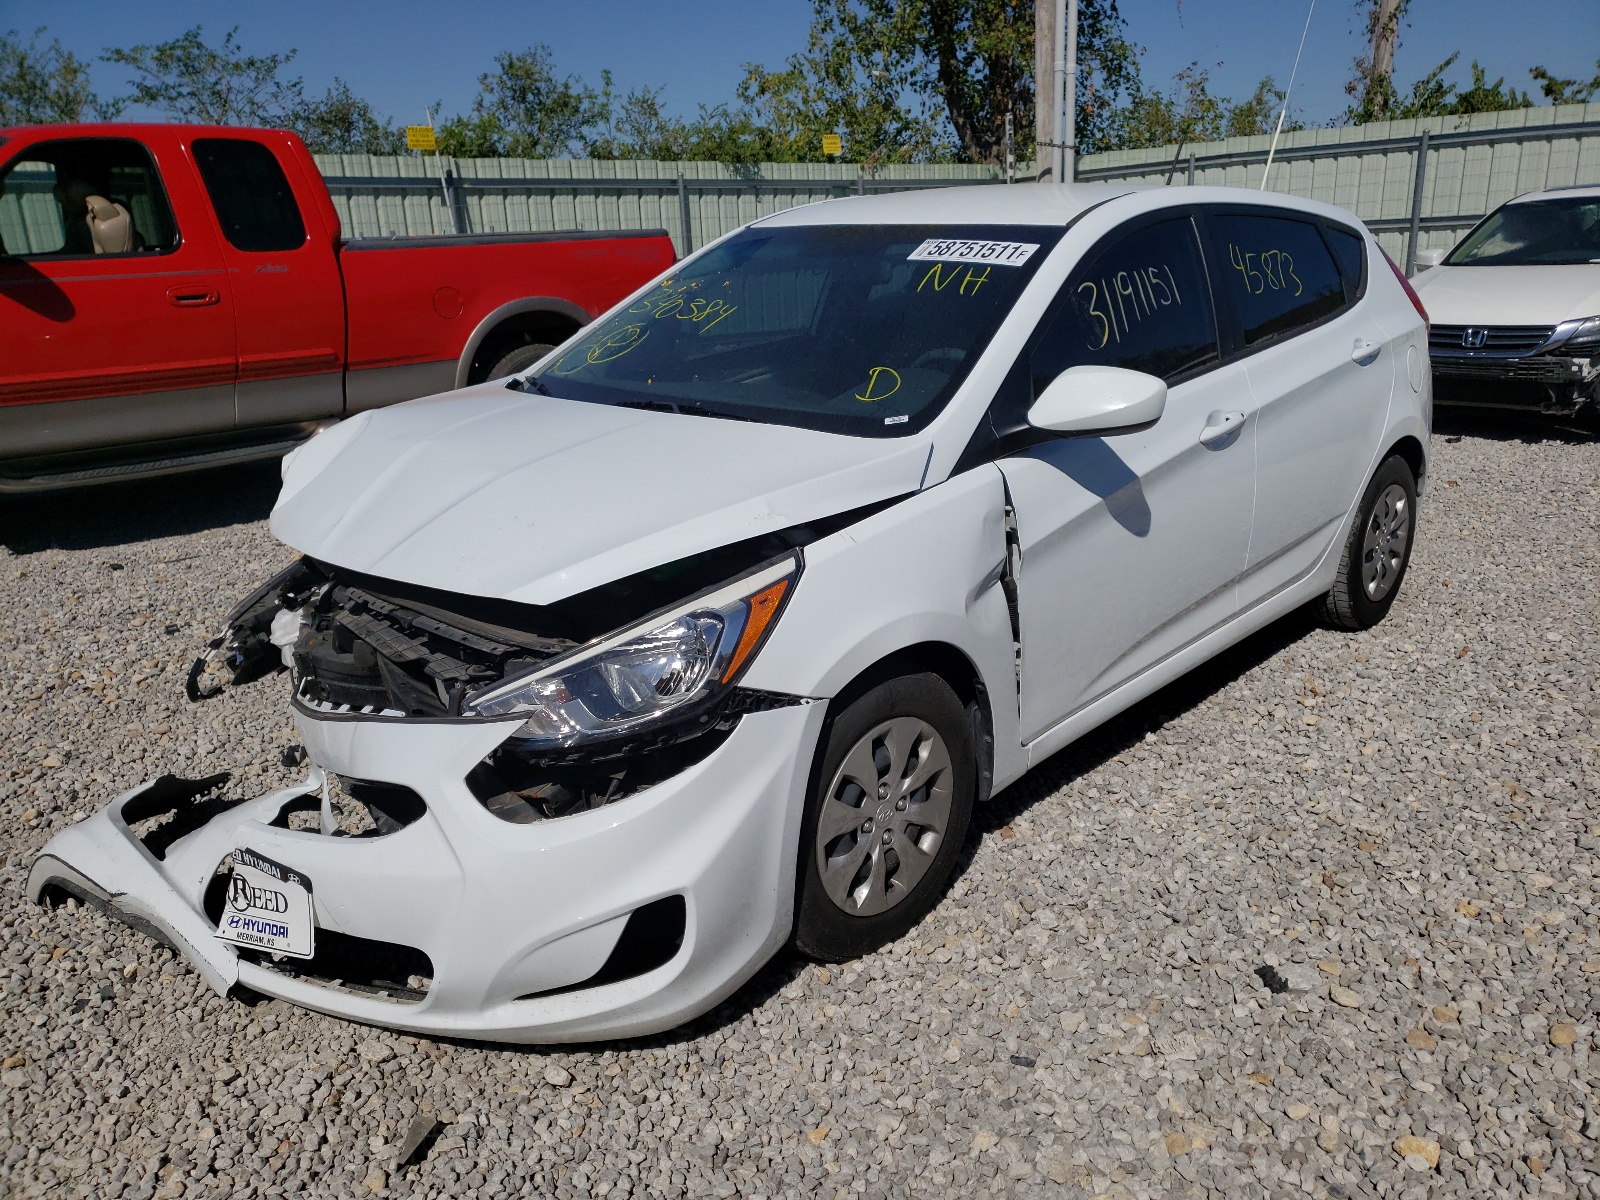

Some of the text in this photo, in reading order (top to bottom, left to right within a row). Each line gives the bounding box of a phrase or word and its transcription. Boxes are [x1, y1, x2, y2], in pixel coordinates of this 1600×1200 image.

[927, 241, 1022, 259] 58751511
[1230, 243, 1302, 296] 45873
[855, 367, 901, 401] D
[243, 852, 281, 879] HYUNDAI
[229, 873, 288, 913] REED
[236, 932, 275, 946] MERRIAM, KS
[242, 918, 289, 938] HYUNDAI
